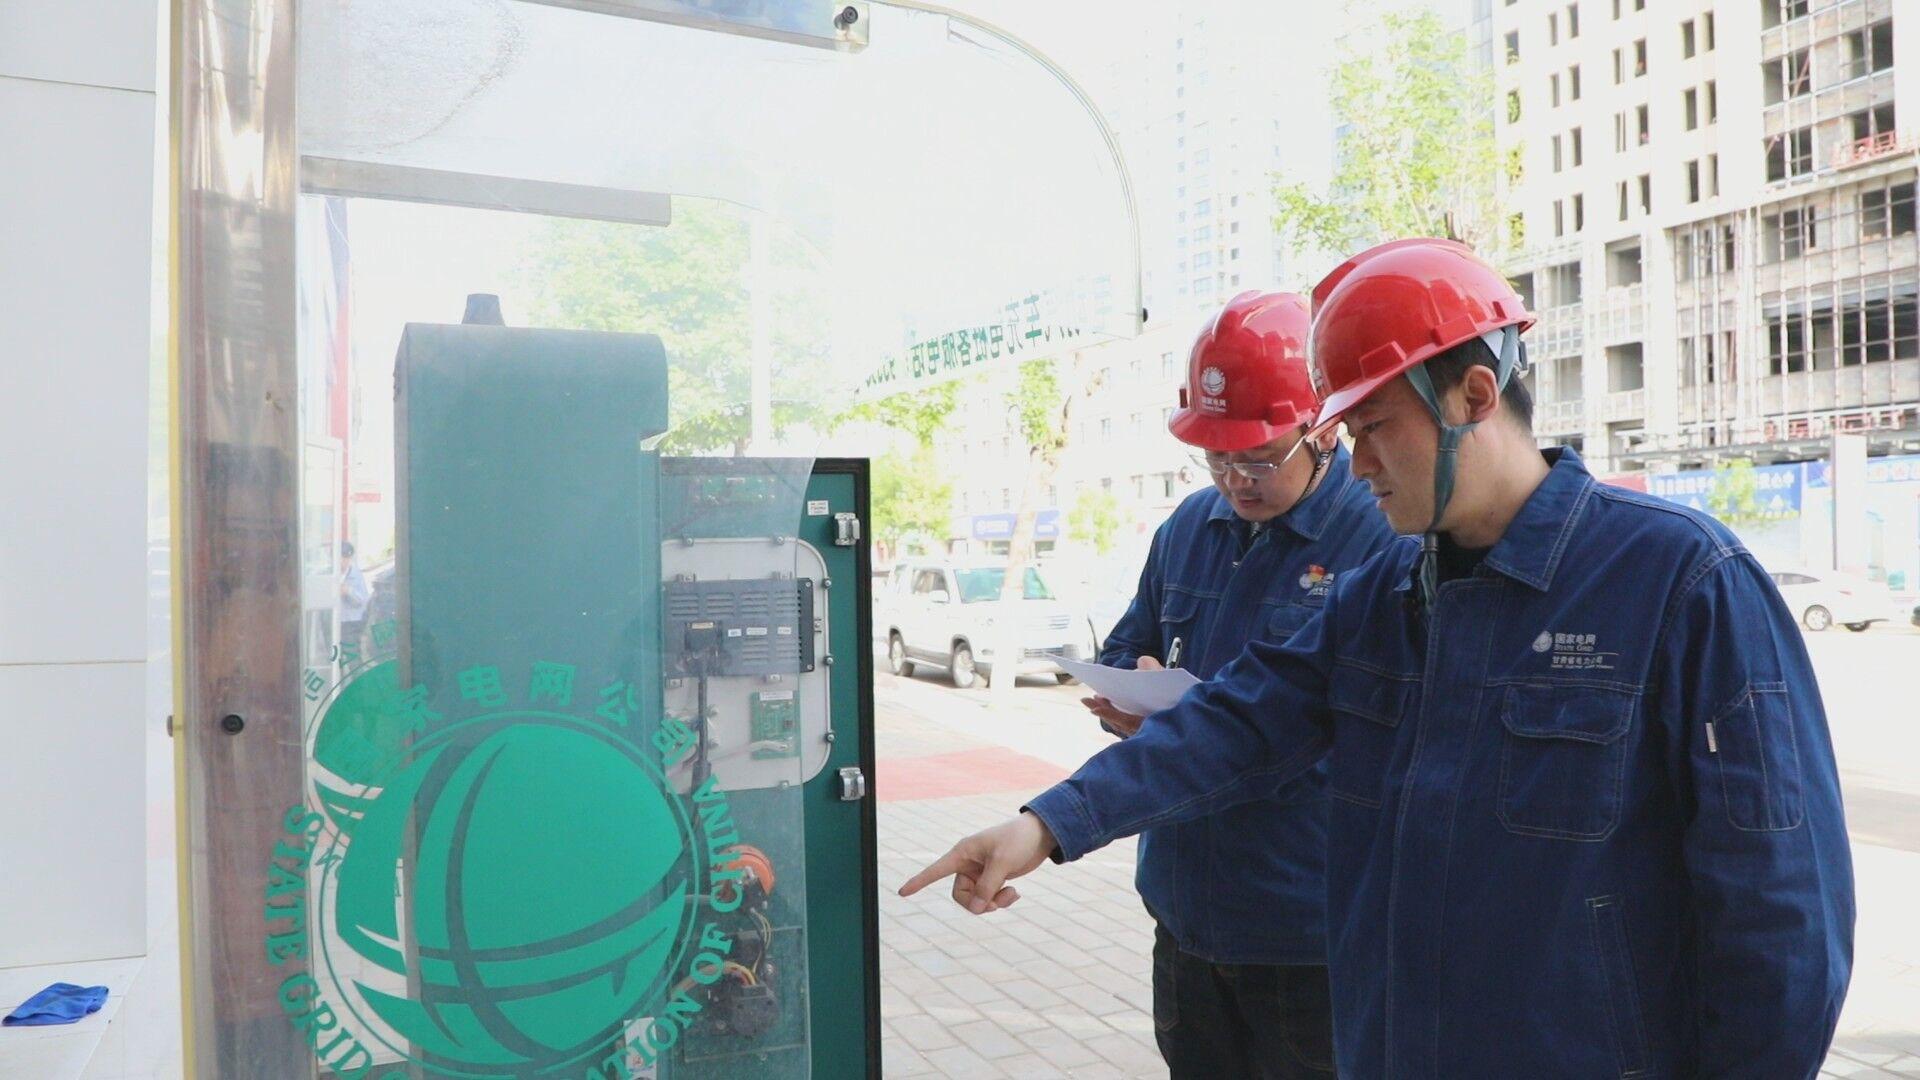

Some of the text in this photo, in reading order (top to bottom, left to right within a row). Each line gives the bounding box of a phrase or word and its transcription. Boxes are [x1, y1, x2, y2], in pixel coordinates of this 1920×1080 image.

[1555, 633, 1596, 645] 国家电网
[264, 804, 325, 966] STATE
[692, 773, 744, 913] CHINA
[690, 923, 733, 985] OF
[278, 972, 373, 1080] GRID
